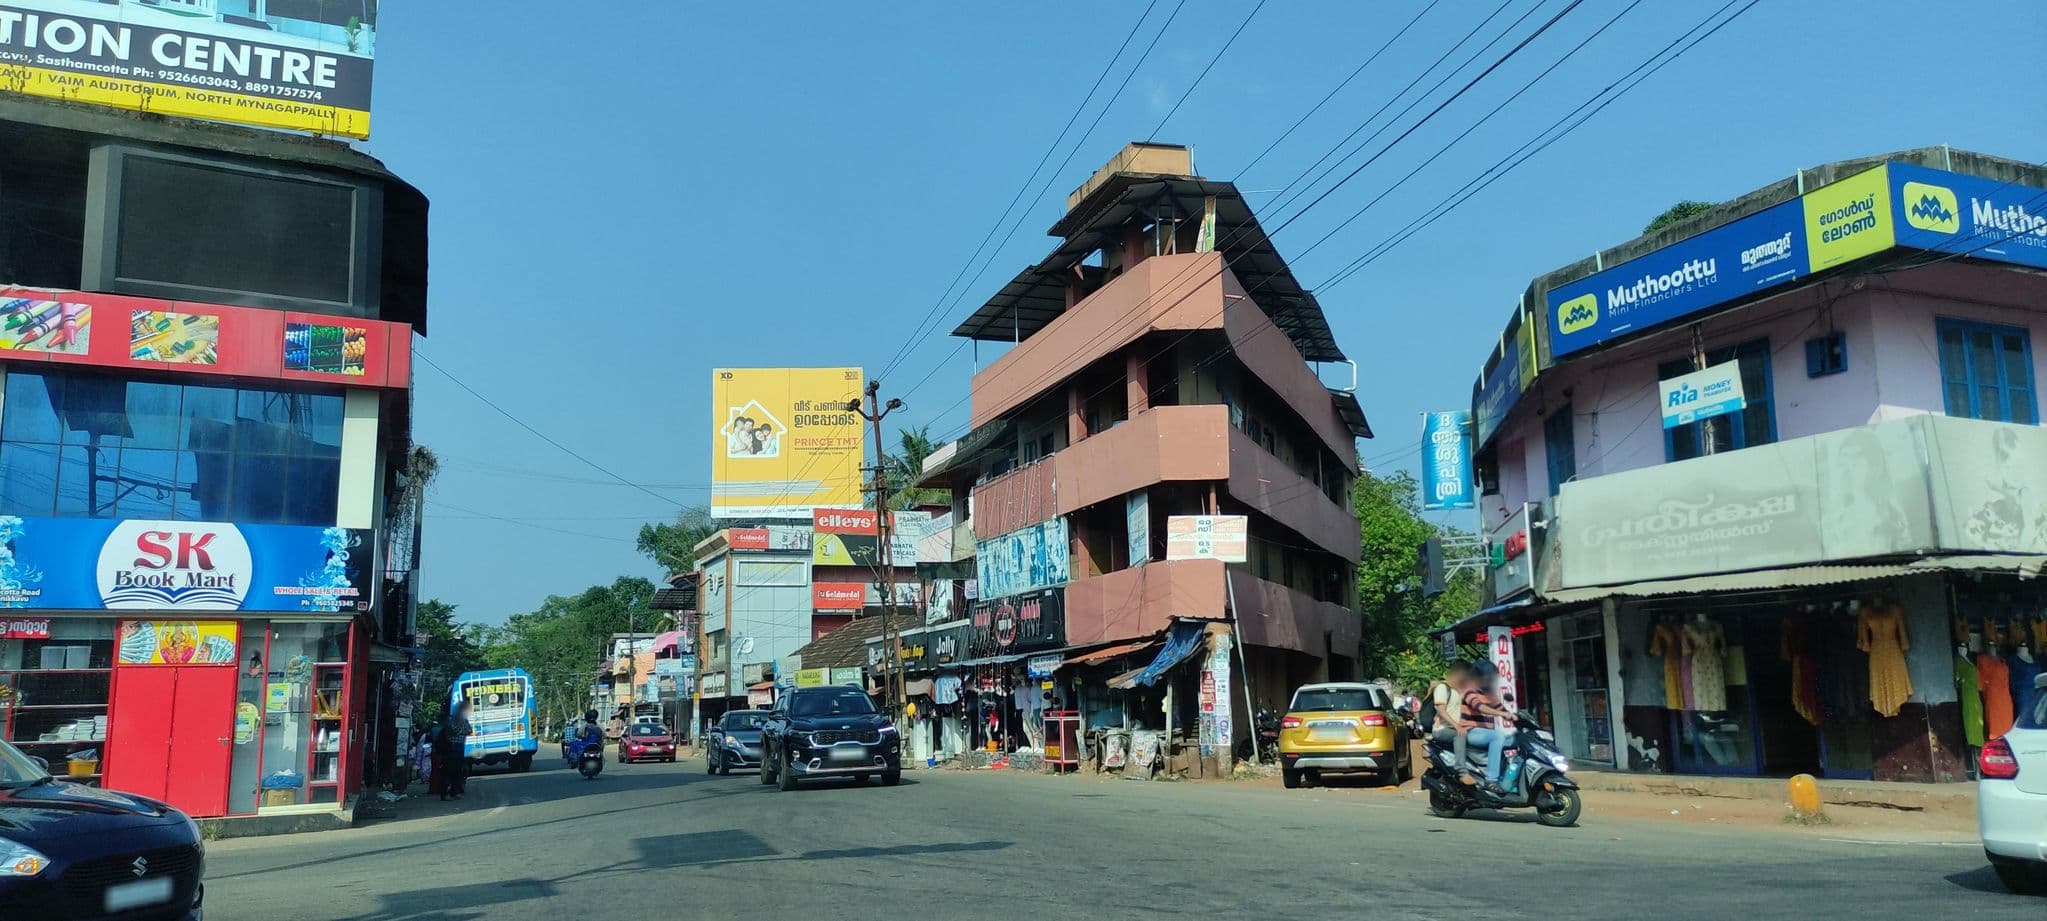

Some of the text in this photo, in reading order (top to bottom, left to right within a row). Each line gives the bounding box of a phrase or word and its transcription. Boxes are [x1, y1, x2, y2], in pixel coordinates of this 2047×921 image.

[0, 10, 338, 89] TION CENTRE
[36, 54, 129, 75] Sasthamcotta
[133, 67, 154, 79] Ph:
[158, 70, 242, 90] 9526603043,
[245, 82, 322, 100] 8891757574
[48, 74, 85, 87] VAIM
[89, 80, 180, 99] AUDITORIUM,
[185, 92, 232, 105] NORTH
[236, 98, 336, 118] MYNAGAPPALLY
[1822, 210, 1876, 243] ലോൺ
[1607, 258, 1716, 310] Muthoottu
[1608, 274, 1717, 318] Mini Financiers Ltd
[1668, 379, 1732, 408] Ria MONEY
[794, 437, 859, 447] PRINCE TMT
[133, 531, 217, 570] SK
[115, 571, 236, 588] Book Mart
[274, 587, 303, 595] WHOLE
[304, 587, 324, 595] SALE
[825, 590, 860, 599] Goldmedal
[936, 636, 956, 657] Jolly
